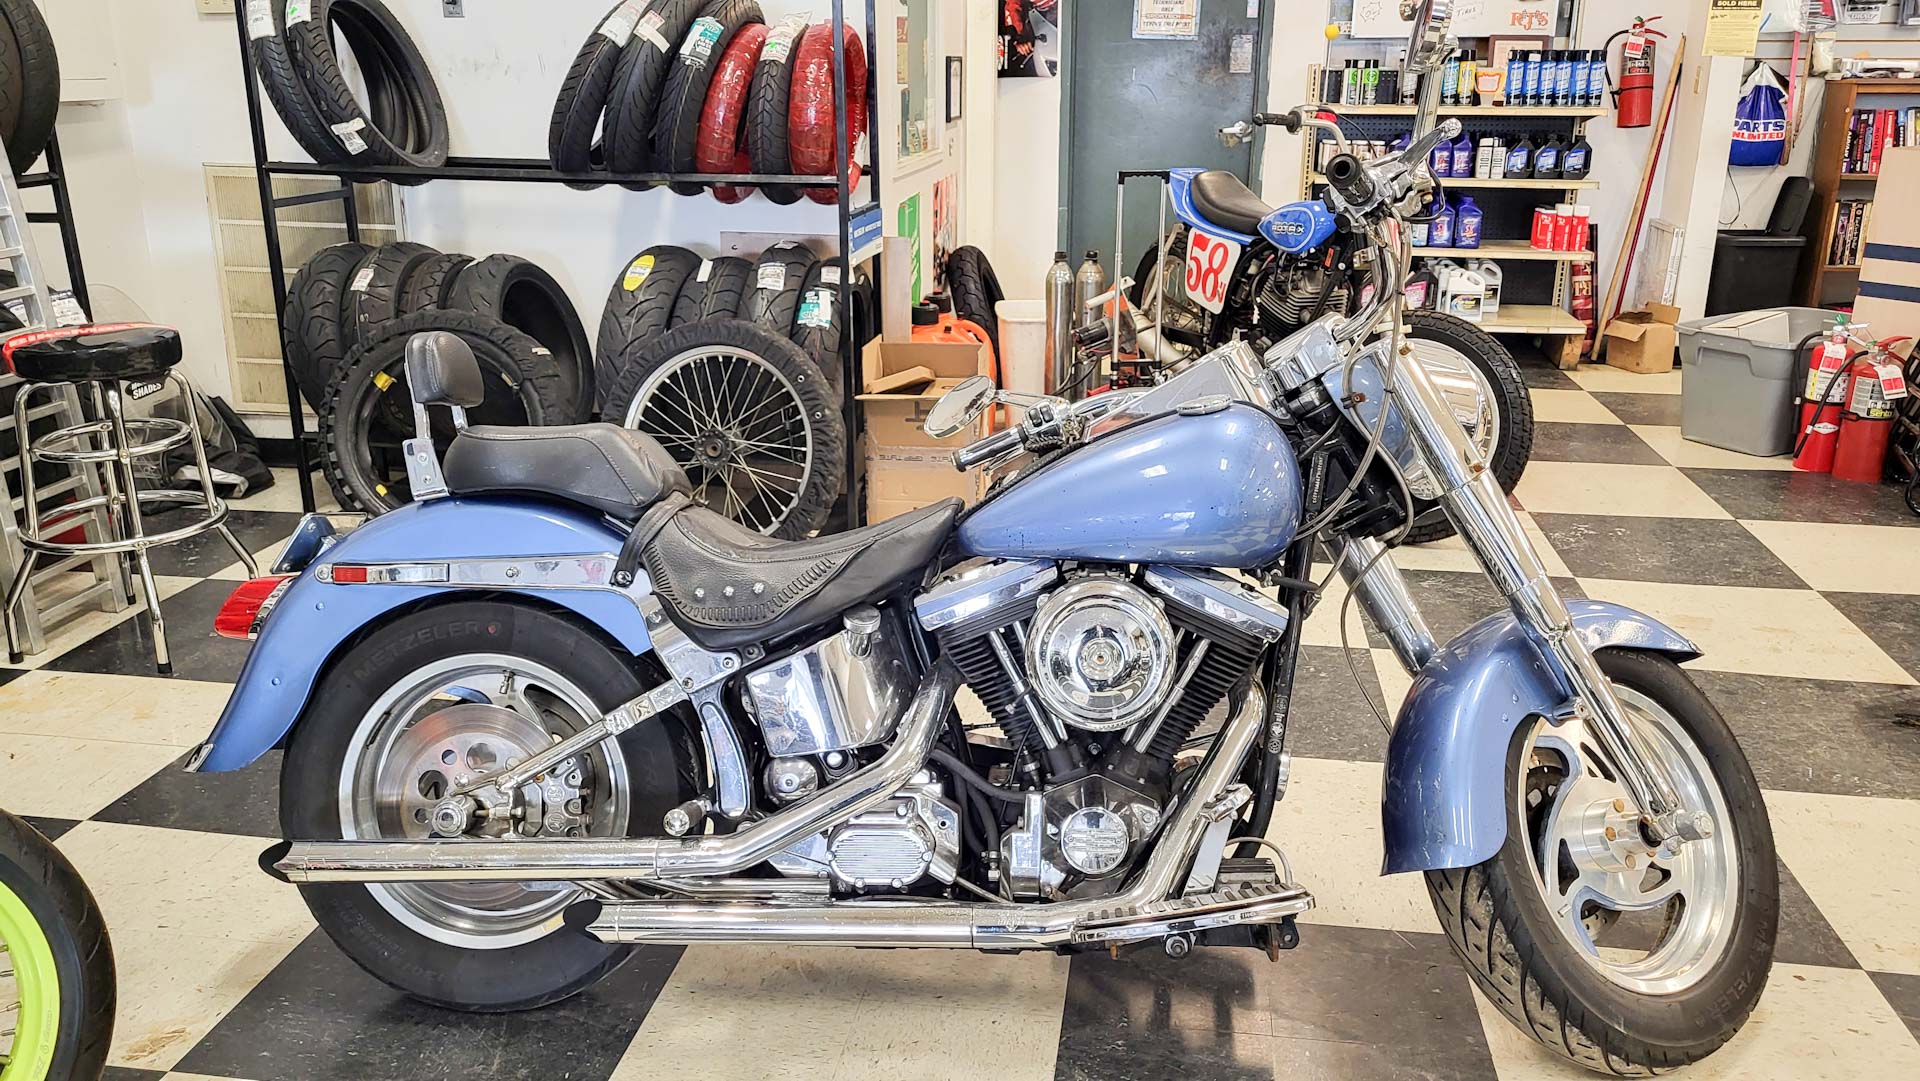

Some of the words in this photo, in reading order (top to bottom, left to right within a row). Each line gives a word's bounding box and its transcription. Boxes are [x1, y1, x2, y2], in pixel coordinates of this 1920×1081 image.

[1734, 120, 1785, 133] PARTS
[1731, 131, 1785, 140] NLIMITED
[1187, 232, 1229, 302] 58
[132, 383, 162, 400] SHADES
[352, 620, 481, 681] METZELER
